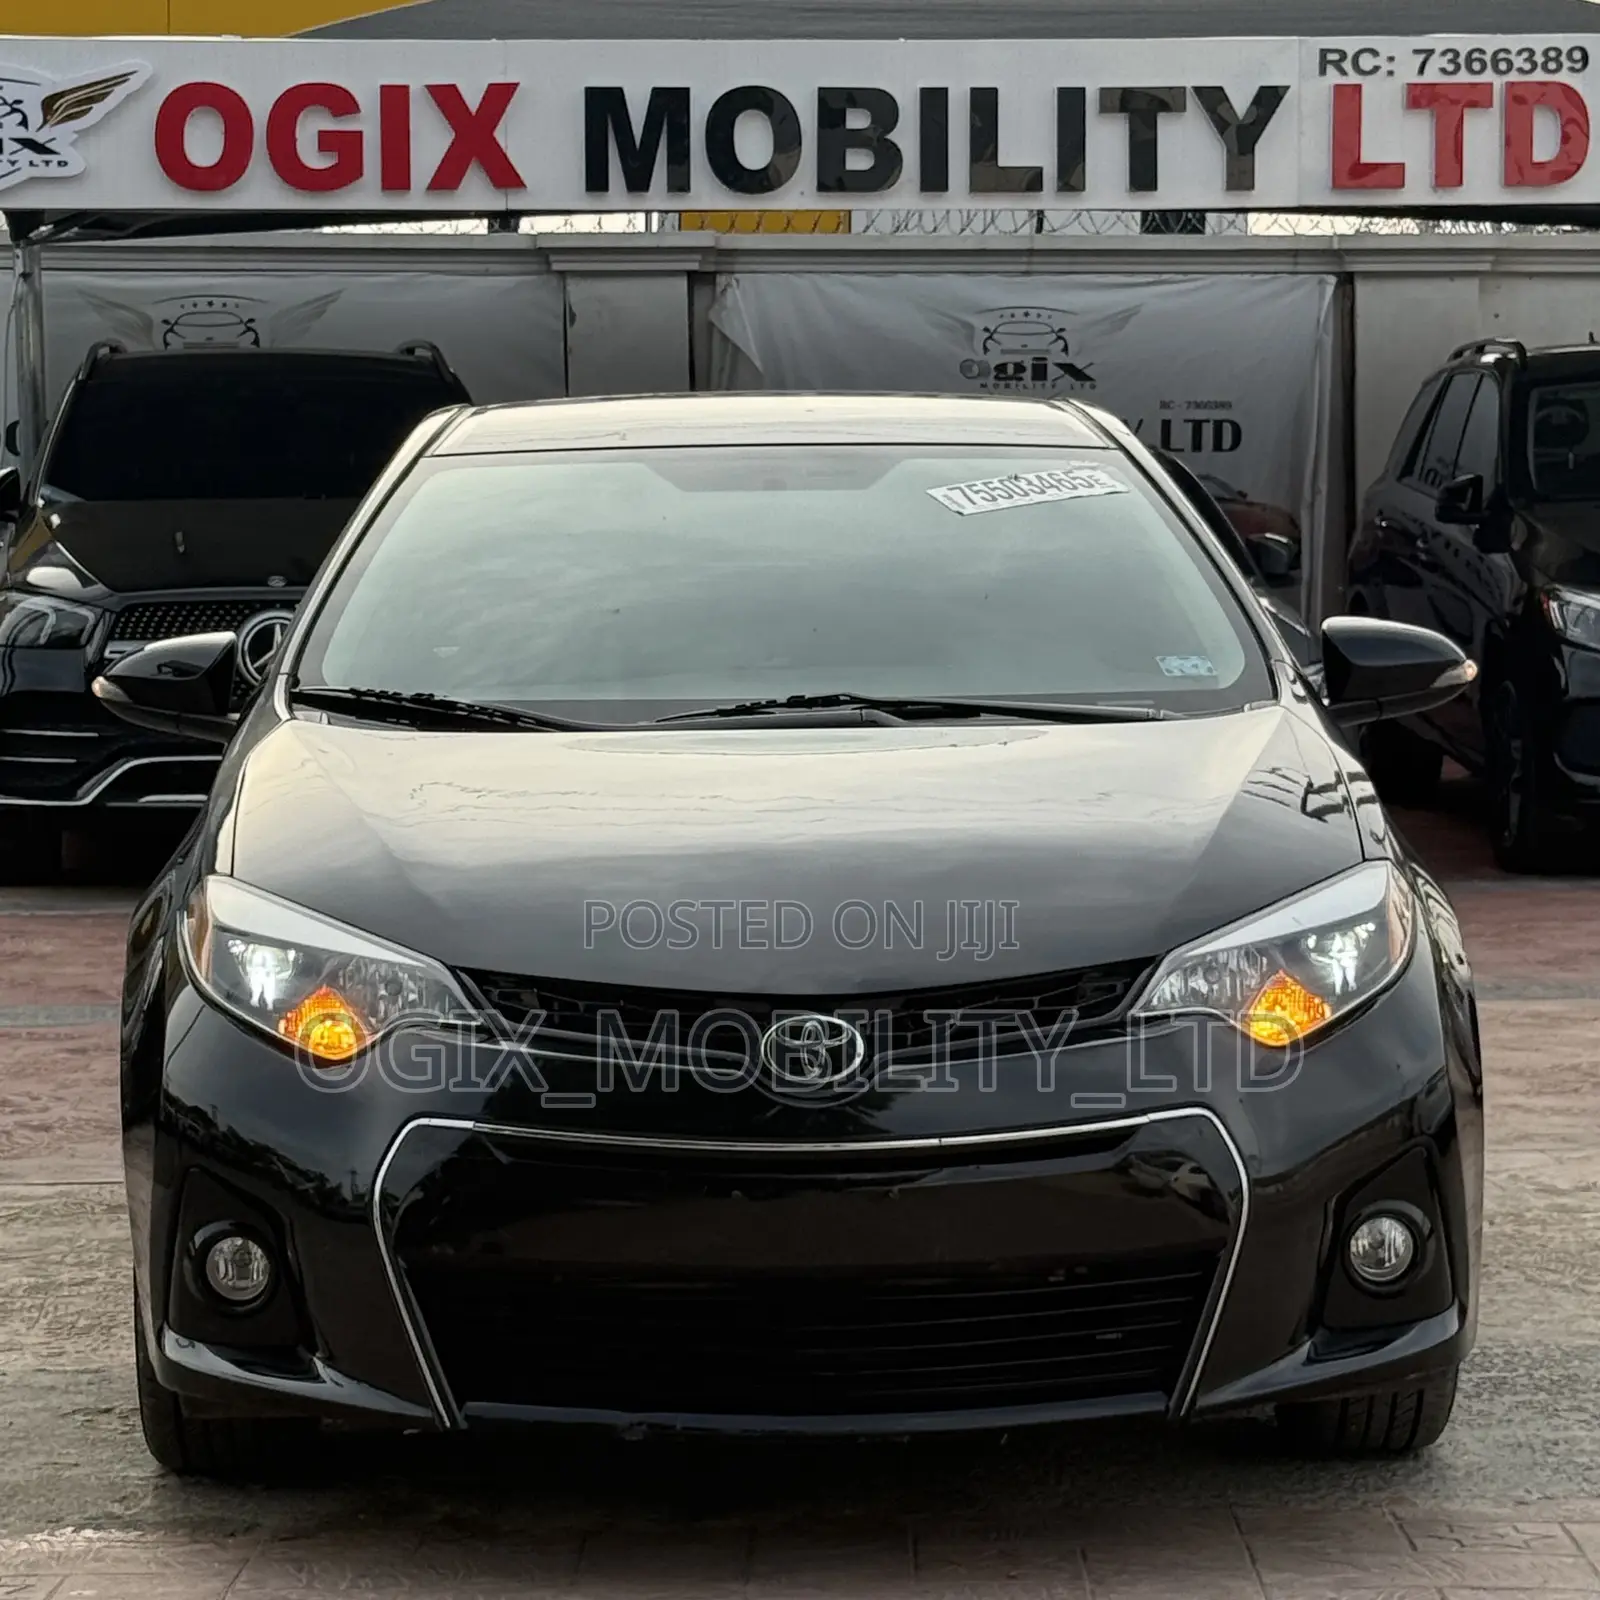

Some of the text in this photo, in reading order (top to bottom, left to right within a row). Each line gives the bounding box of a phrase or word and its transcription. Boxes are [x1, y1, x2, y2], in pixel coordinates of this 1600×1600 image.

[1318, 46, 1589, 77] RC: 7366389
[155, 81, 1590, 193] OGIX MOBILITY LTD
[28, 159, 69, 167] LTD
[1160, 418, 1242, 453] LTD
[947, 469, 1094, 506] 75503465
